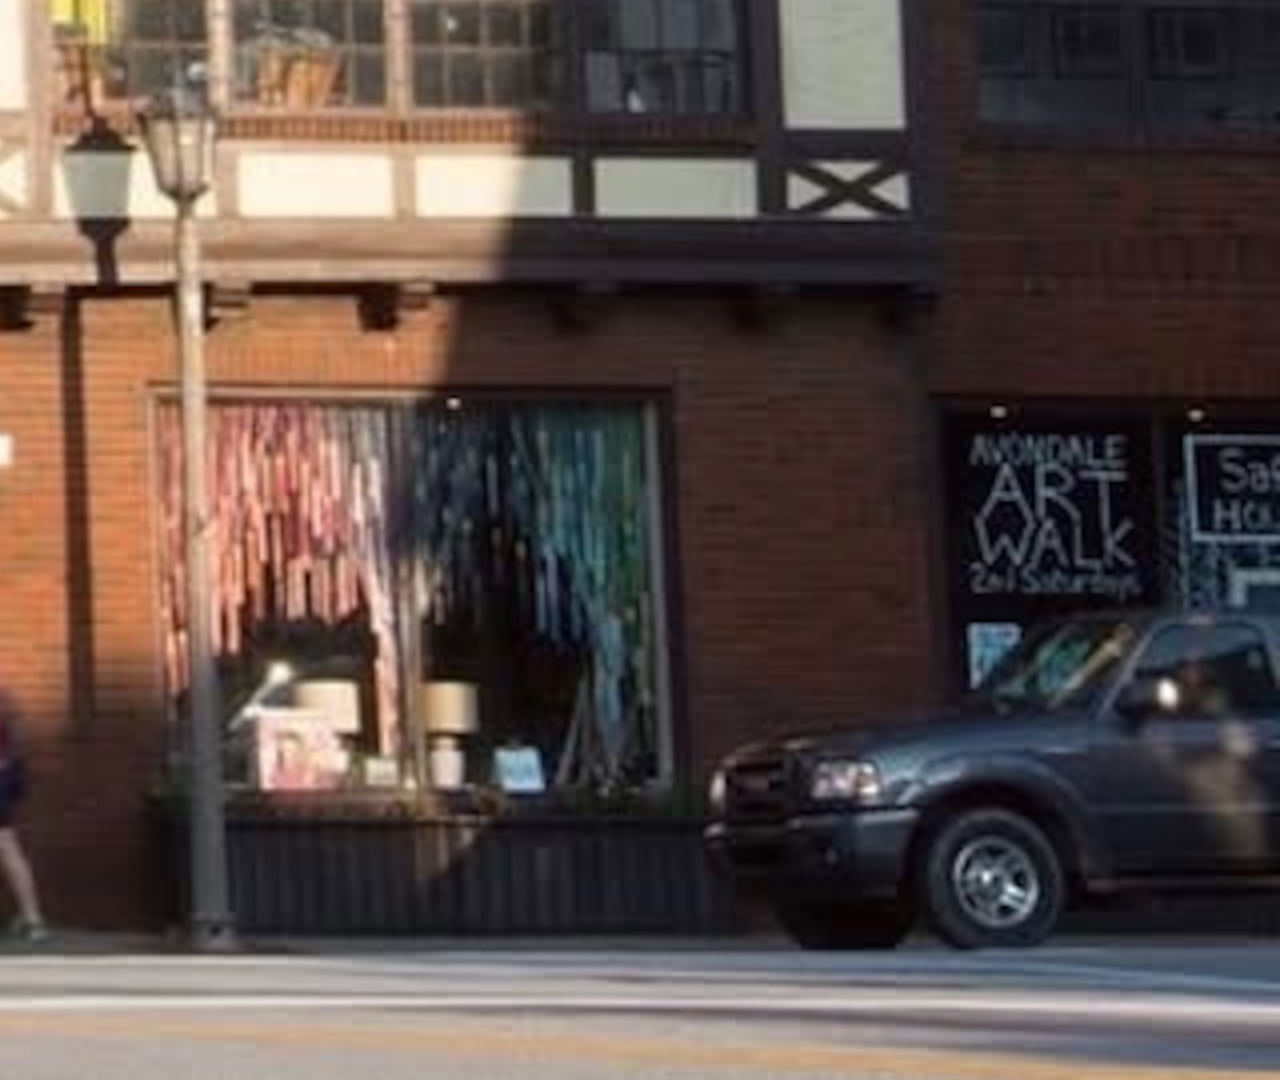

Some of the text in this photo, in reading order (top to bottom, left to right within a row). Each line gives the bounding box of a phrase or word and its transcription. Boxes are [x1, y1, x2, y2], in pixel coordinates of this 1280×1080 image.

[969, 433, 1130, 469] AVONDALE
[977, 462, 1130, 526] ART
[973, 514, 1138, 568] WALK
